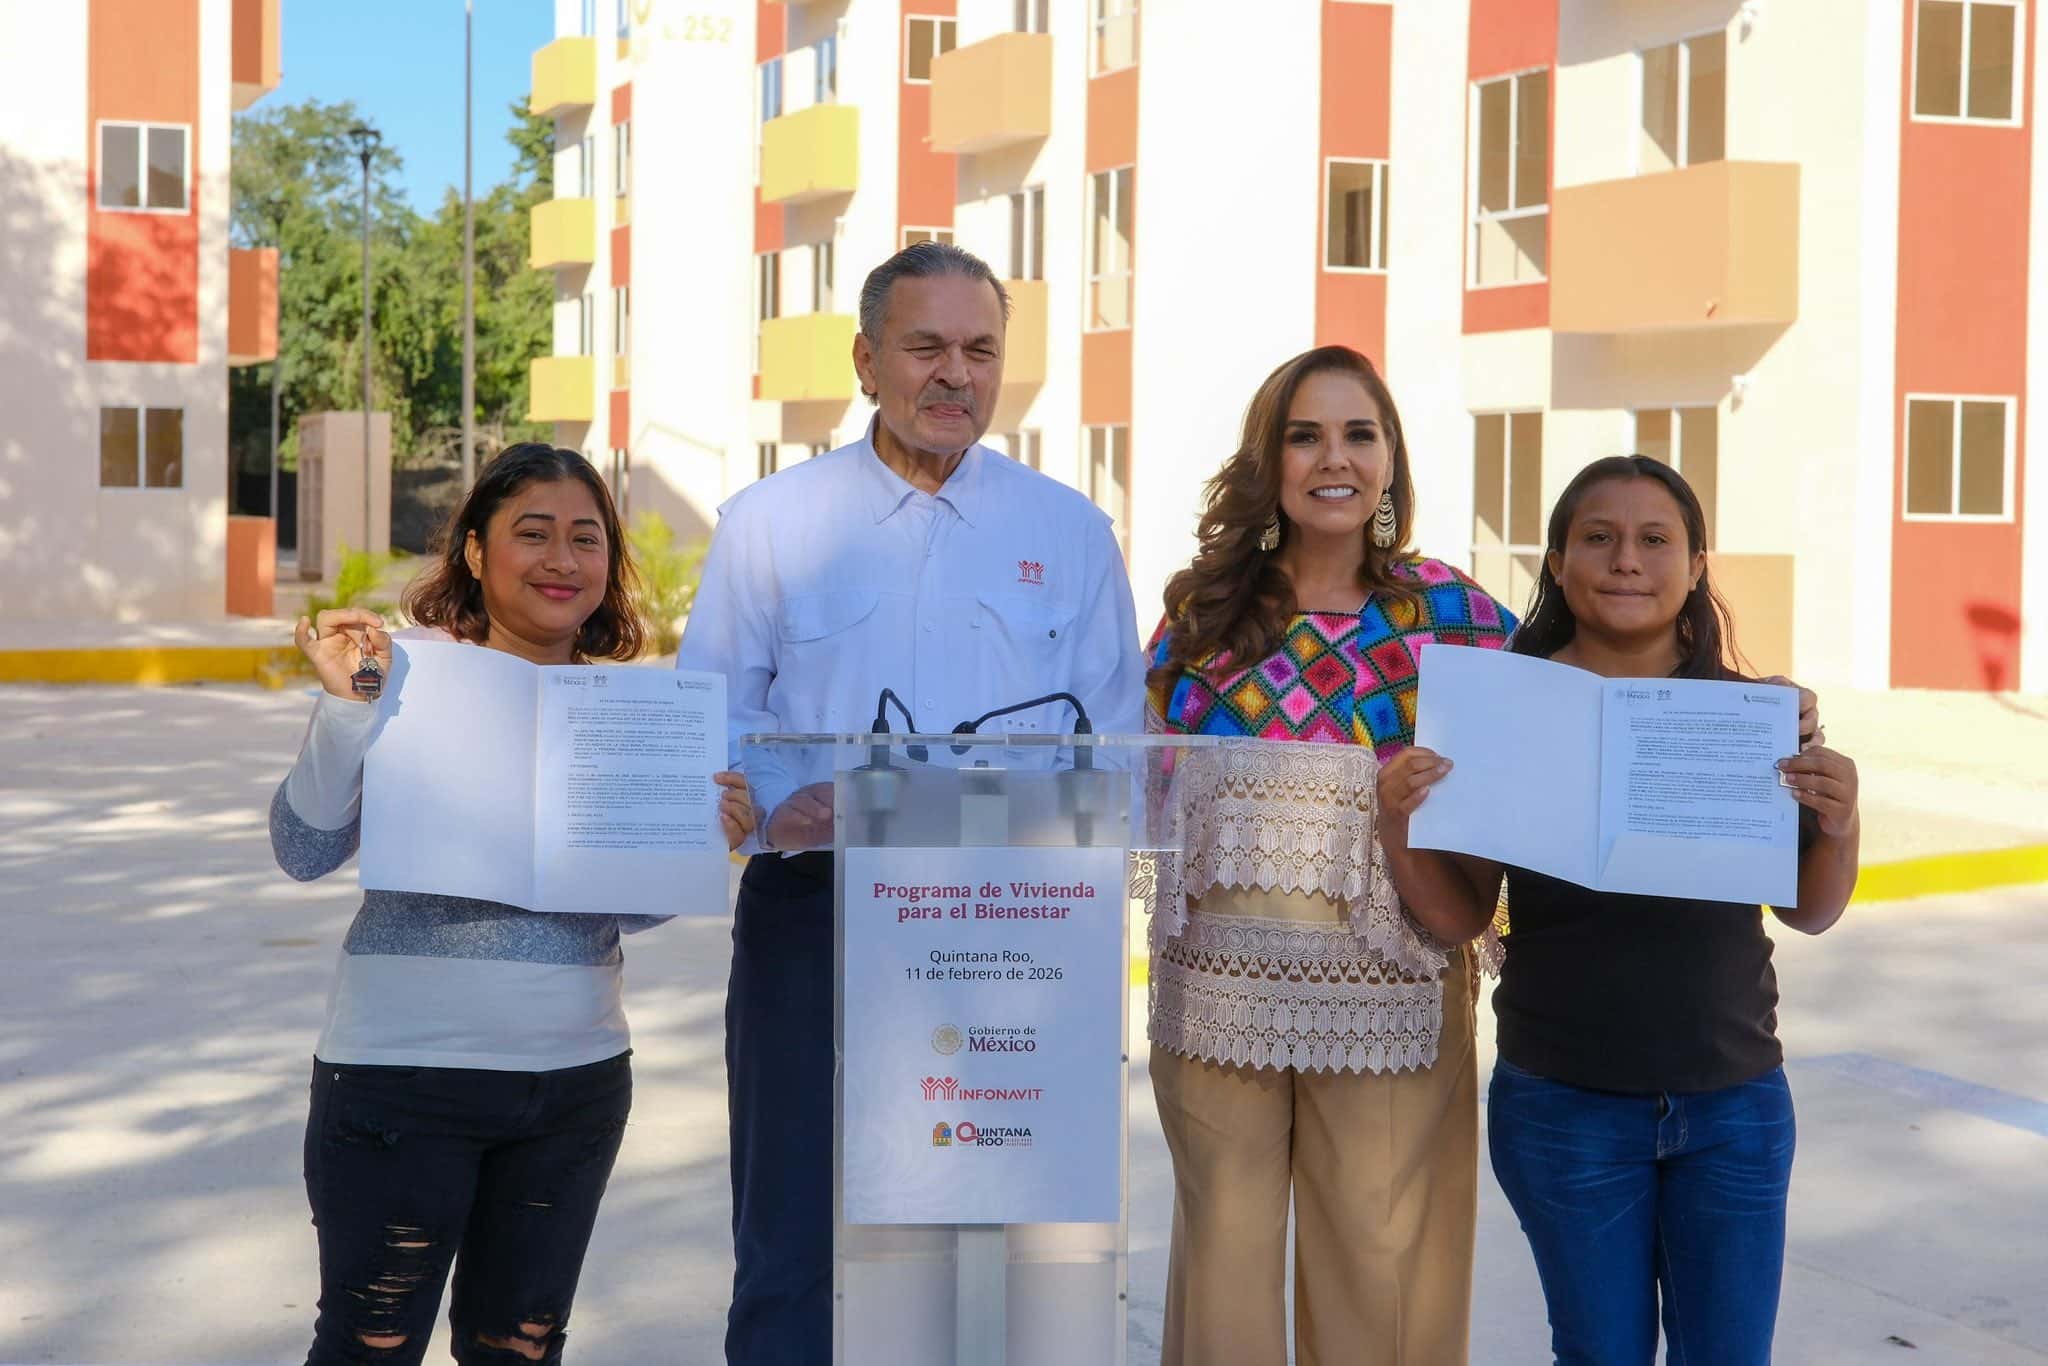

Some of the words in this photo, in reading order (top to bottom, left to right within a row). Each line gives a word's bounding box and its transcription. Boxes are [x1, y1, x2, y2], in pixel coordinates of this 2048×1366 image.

[873, 882, 971, 903] Programa
[979, 882, 1002, 898] de
[1008, 881, 1096, 899] Vivienda
[897, 906, 942, 923] para
[949, 903, 968, 919] el
[974, 903, 1071, 919] Bienestar
[929, 950, 998, 964] Quintana
[1002, 950, 1035, 964] Roo,
[905, 968, 921, 980] 11
[926, 967, 945, 980] de
[948, 967, 1002, 980] febrero
[1006, 967, 1024, 980] de
[1028, 967, 1063, 980] 2026
[968, 1025, 1021, 1036] Gobierno
[1023, 1025, 1037, 1036] de
[968, 1035, 1037, 1052] México
[959, 1089, 1043, 1101] INFONAVIT
[955, 1121, 1032, 1143] QUINTANA
[976, 1137, 1004, 1147] ROO
